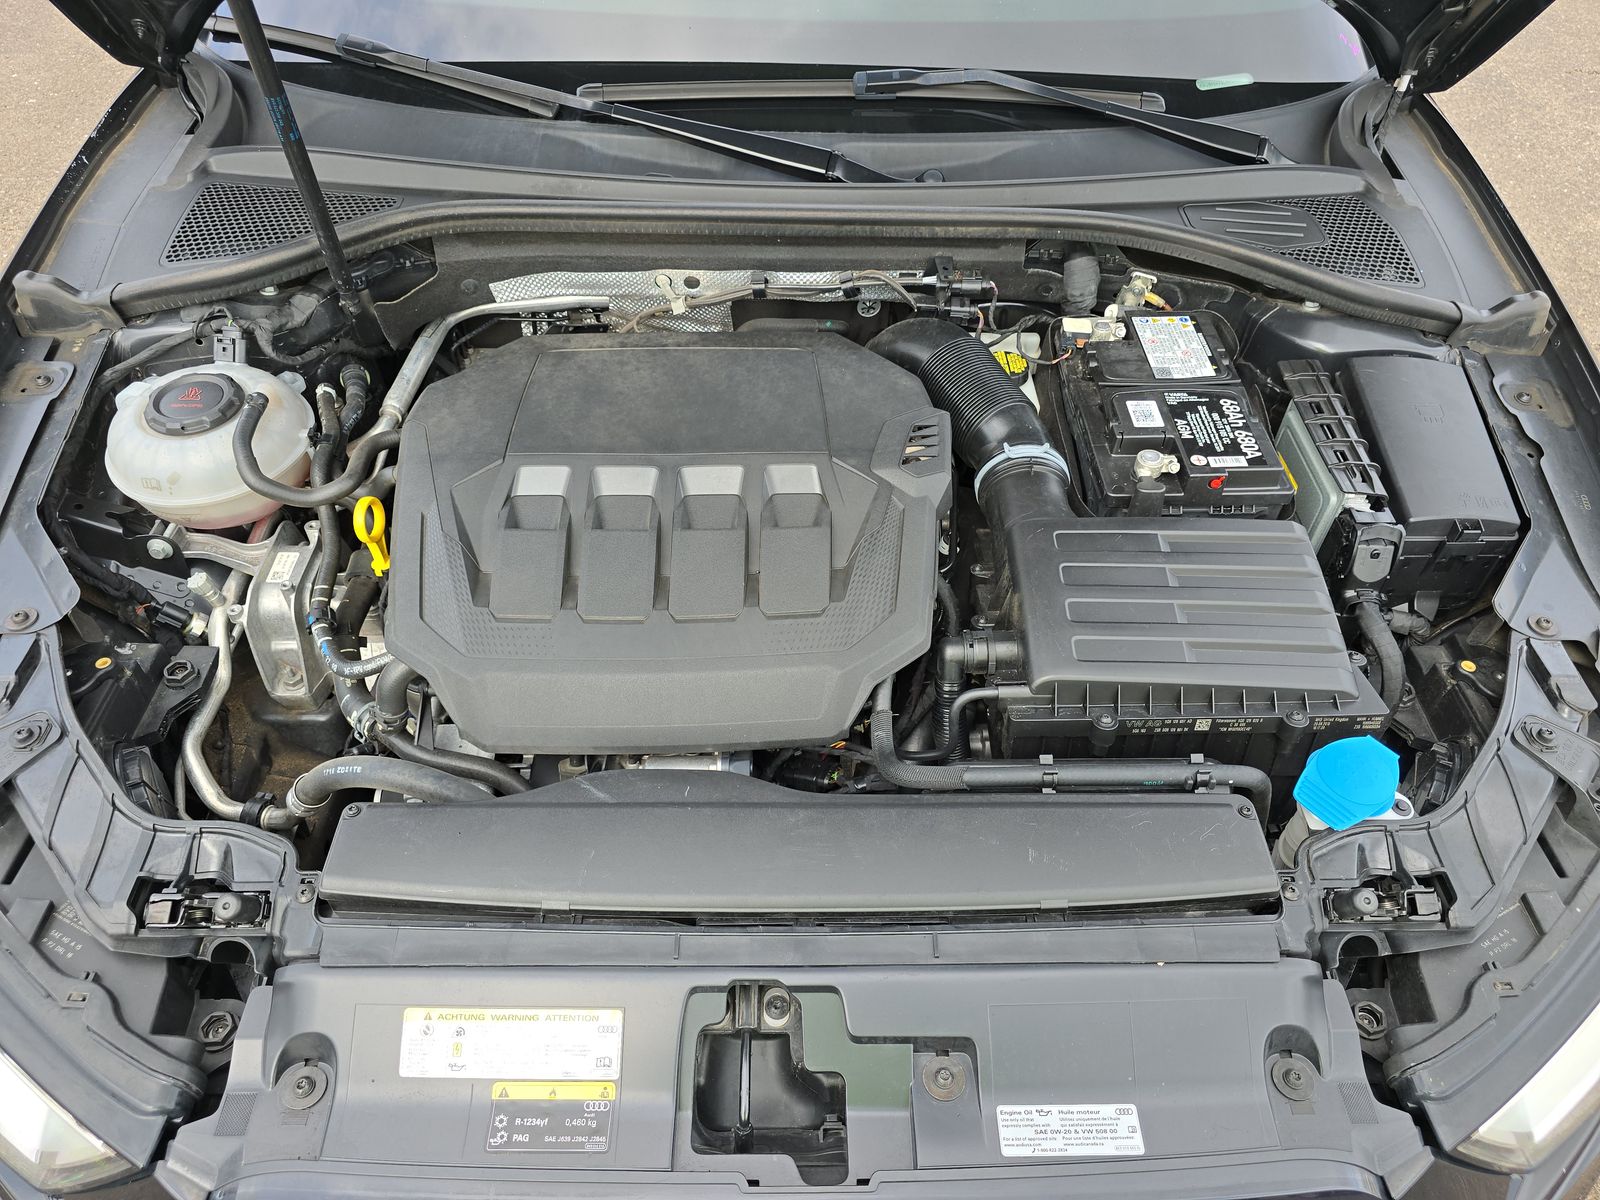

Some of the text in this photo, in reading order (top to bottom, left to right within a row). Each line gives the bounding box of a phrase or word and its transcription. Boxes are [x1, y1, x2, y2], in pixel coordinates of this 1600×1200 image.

[1174, 418, 1194, 439] AGM
[1219, 398, 1263, 460] 68Ah 680A
[437, 1013, 600, 1022] ACHTUNG WARNING ATTENTION
[515, 1117, 597, 1128] R-1234yf 0,460 kg
[512, 1134, 529, 1142] PAG
